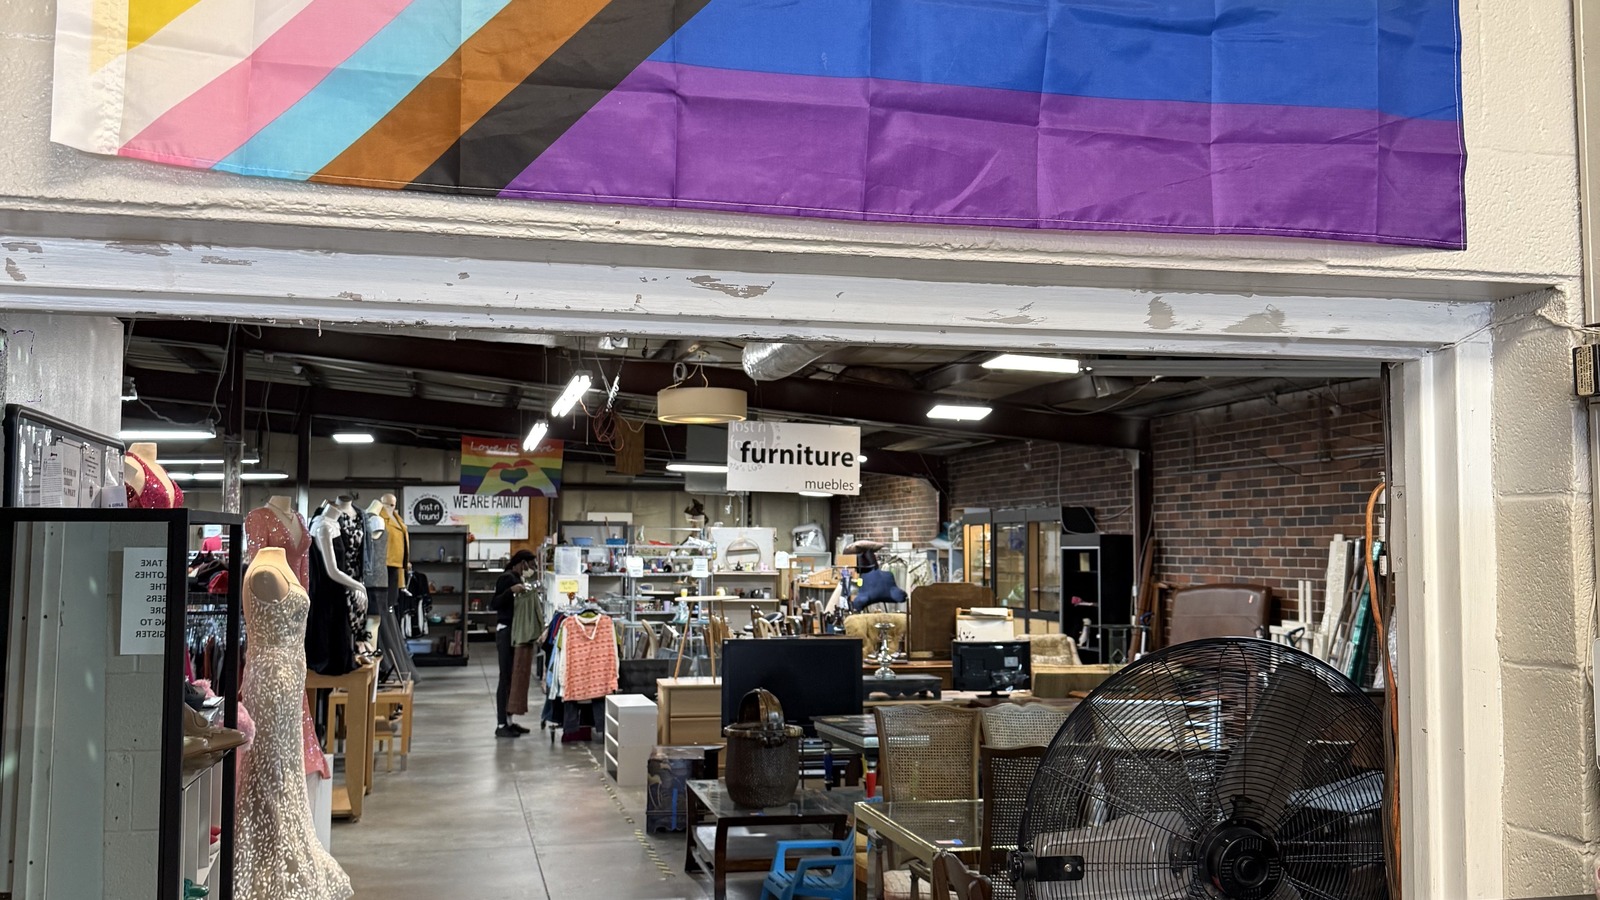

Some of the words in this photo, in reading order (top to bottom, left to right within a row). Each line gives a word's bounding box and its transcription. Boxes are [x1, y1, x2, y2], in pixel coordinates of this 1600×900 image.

[732, 420, 754, 432] lost
[470, 441, 501, 452] Love
[731, 434, 766, 451] fond
[740, 441, 854, 467] furniture
[804, 479, 854, 491] muebles
[420, 503, 433, 511] lost
[453, 495, 468, 508] WE
[470, 495, 489, 508] ARE
[491, 495, 524, 508] FAMILY
[418, 512, 440, 521] found
